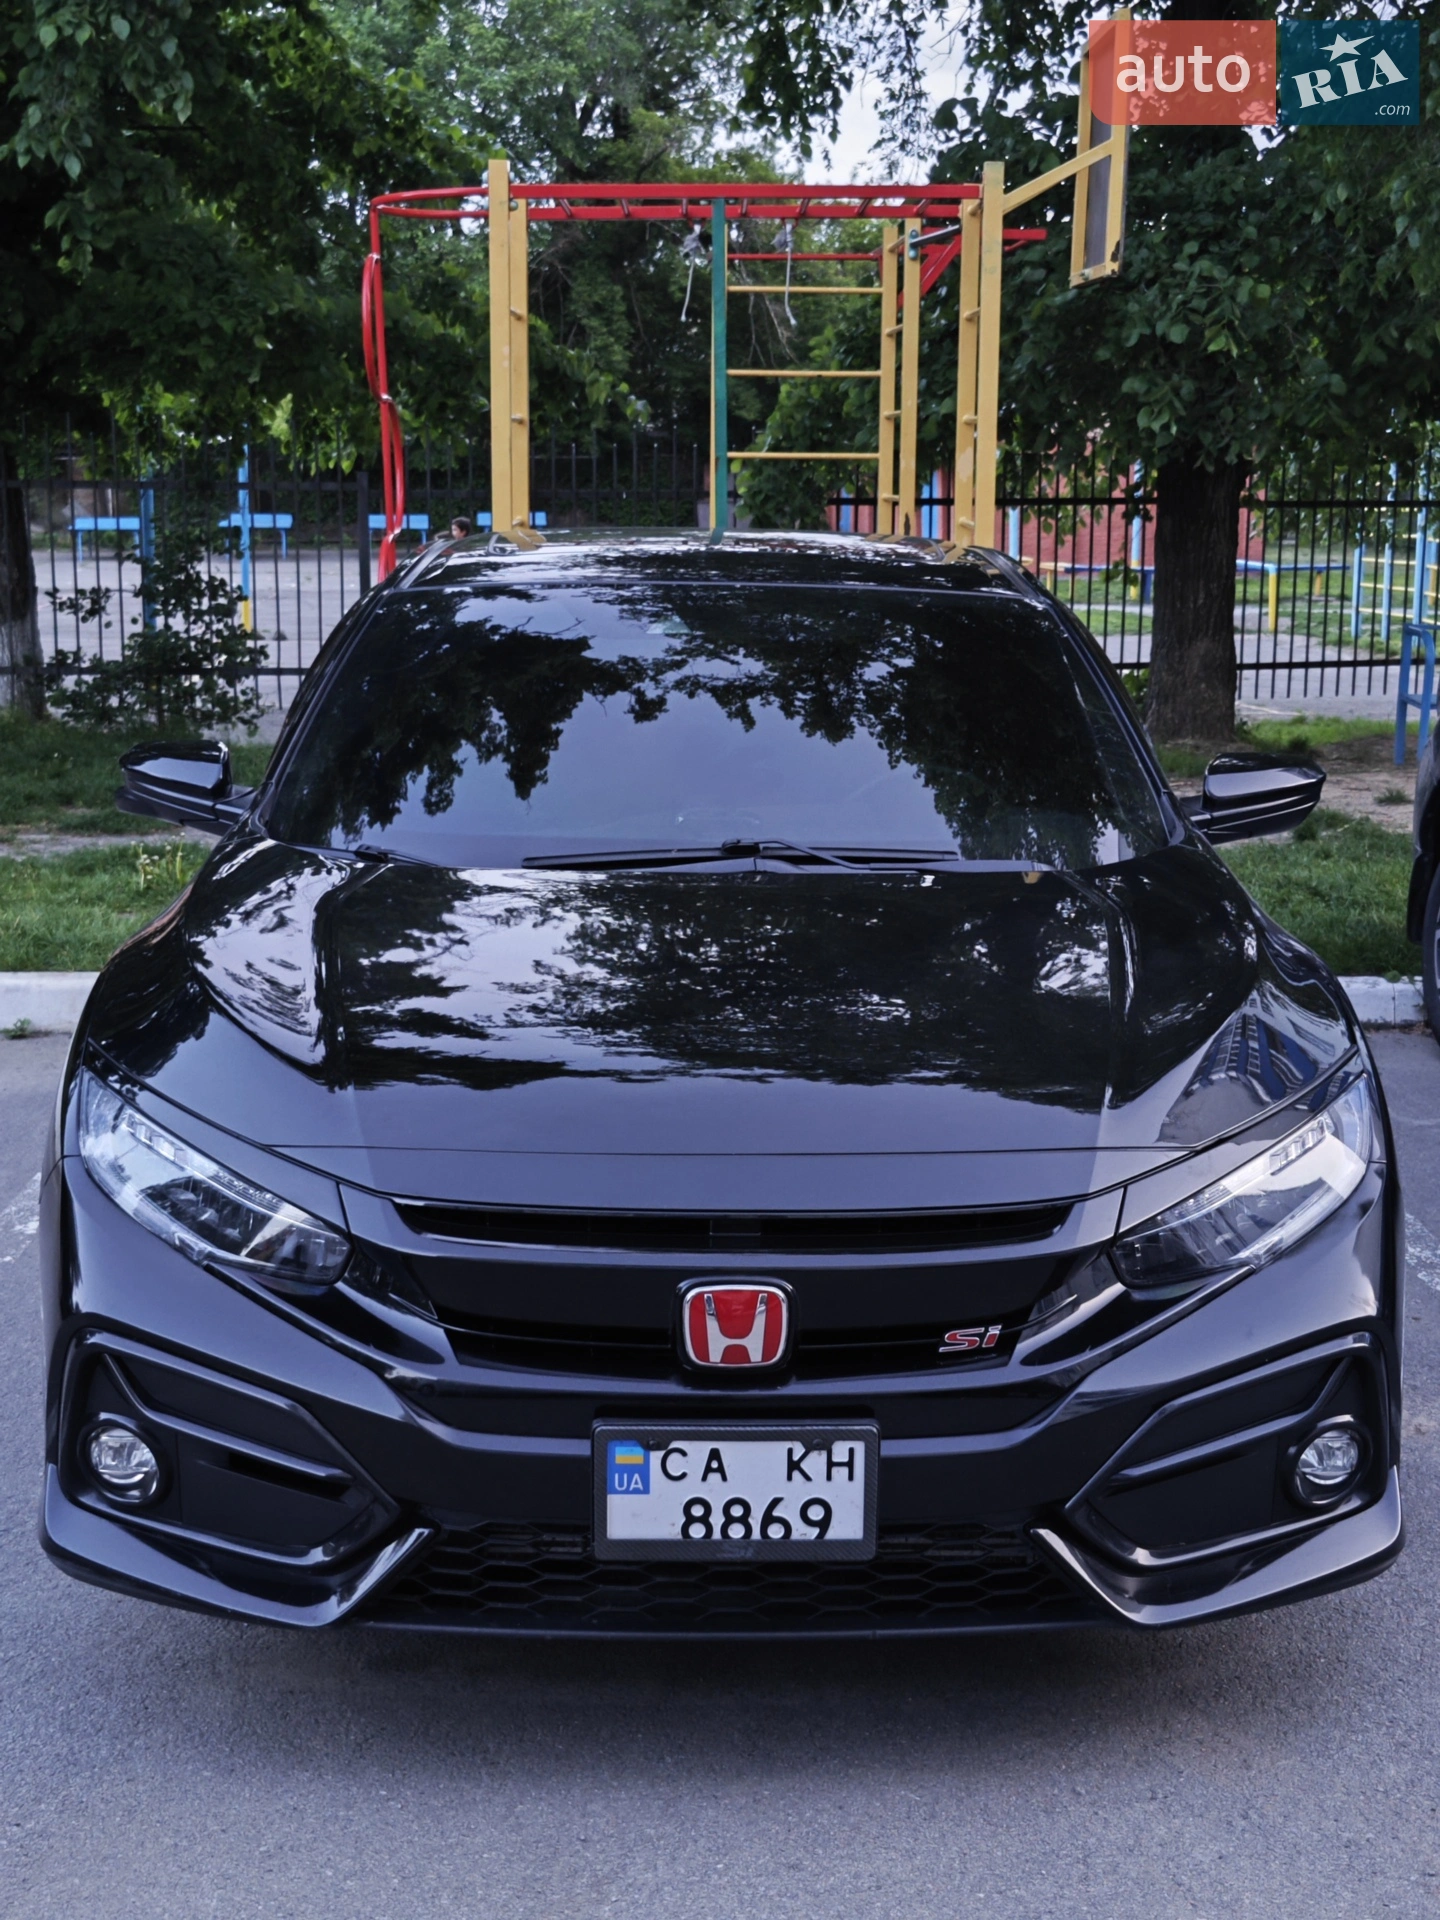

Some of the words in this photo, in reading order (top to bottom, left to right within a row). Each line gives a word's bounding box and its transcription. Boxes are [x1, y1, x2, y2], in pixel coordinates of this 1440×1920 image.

[939, 1324, 1002, 1353] Si
[660, 1447, 728, 1482] CA
[786, 1447, 855, 1482] KH
[614, 1473, 643, 1491] UA
[681, 1497, 833, 1539] 8869
